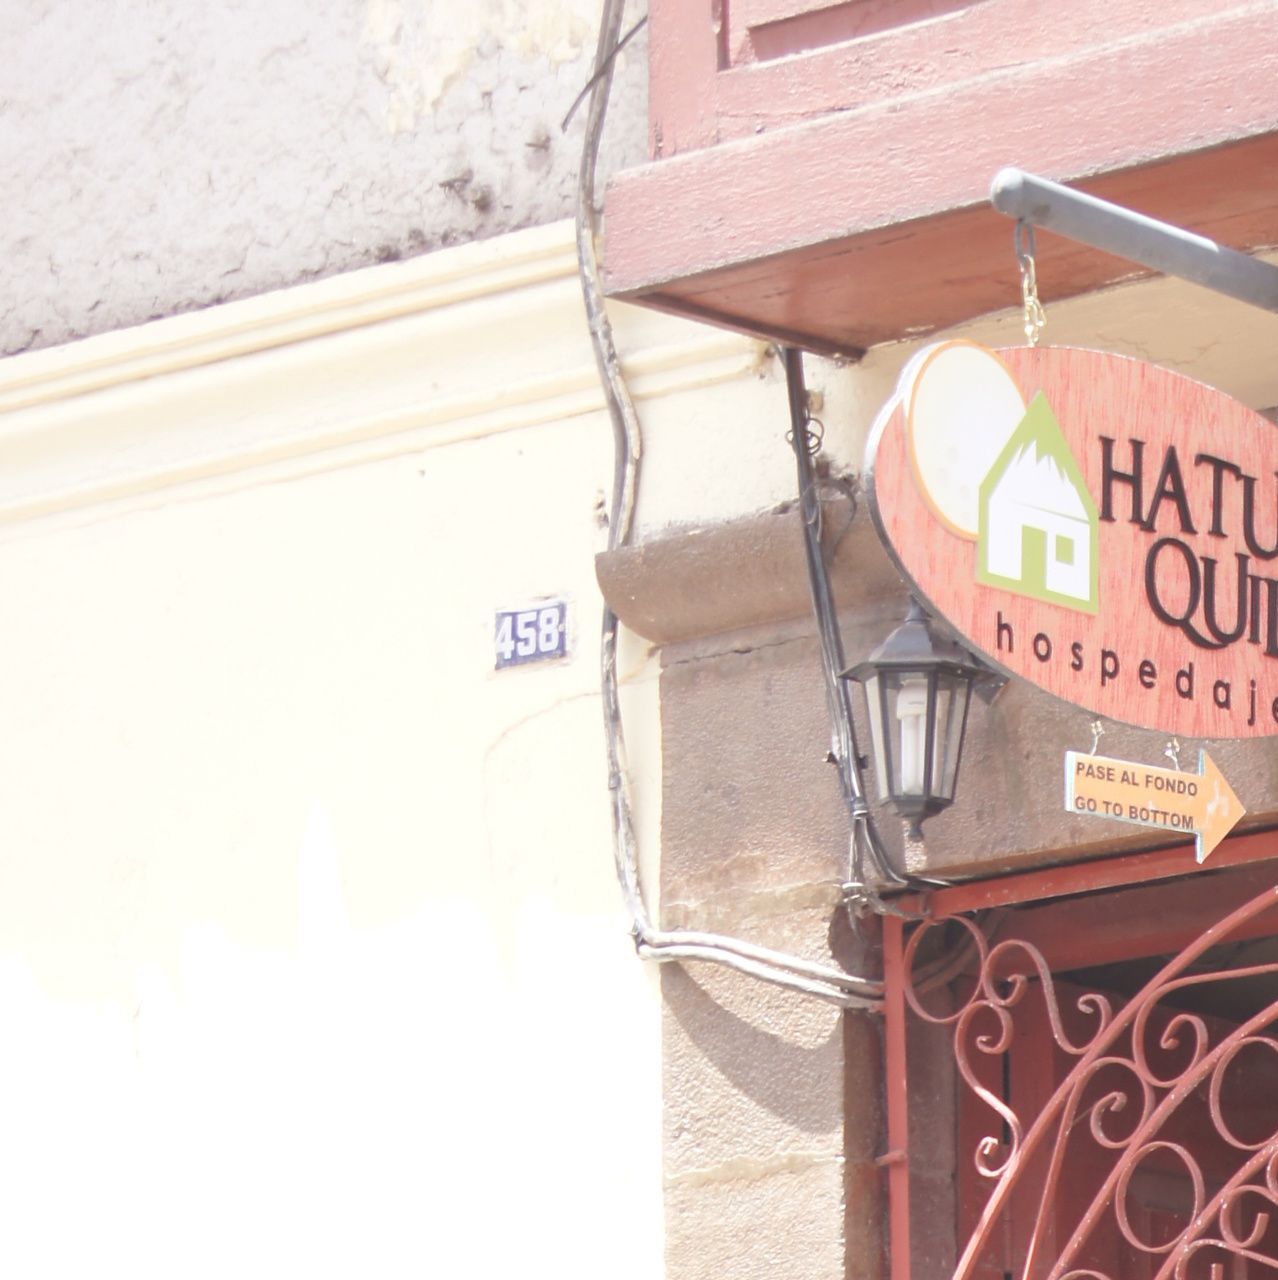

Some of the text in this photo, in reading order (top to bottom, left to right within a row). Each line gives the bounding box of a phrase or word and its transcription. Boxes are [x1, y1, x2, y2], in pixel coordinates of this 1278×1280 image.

[496, 607, 560, 660] 458
[1076, 761, 1198, 797] PASE AL FONDO
[1074, 795, 1195, 830] GO TO BOTTOM
